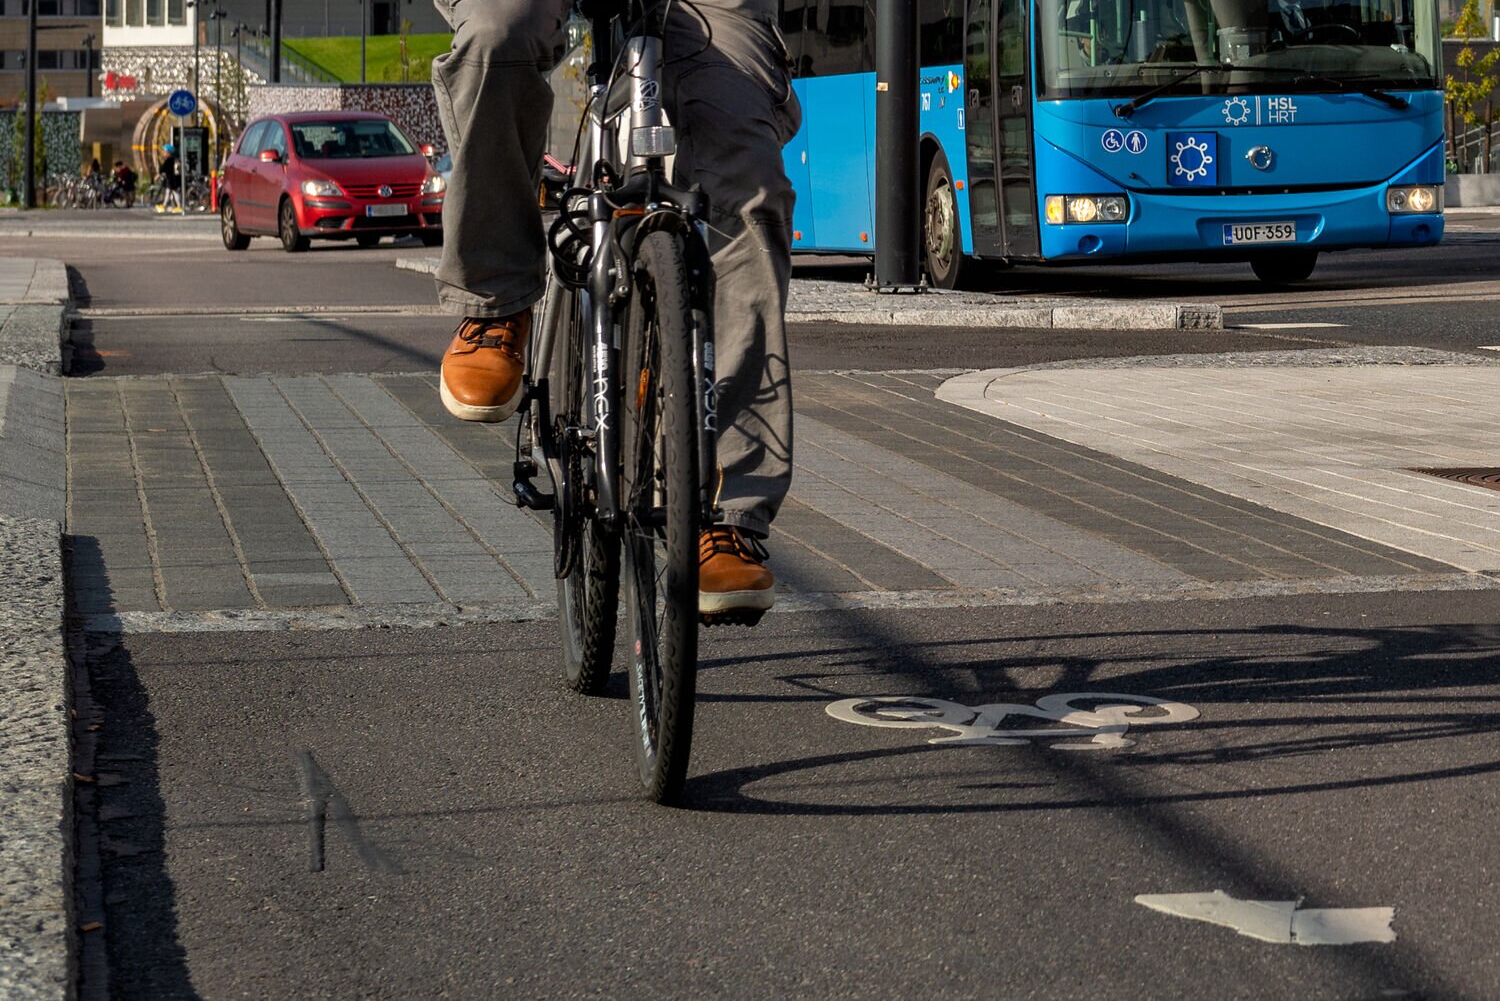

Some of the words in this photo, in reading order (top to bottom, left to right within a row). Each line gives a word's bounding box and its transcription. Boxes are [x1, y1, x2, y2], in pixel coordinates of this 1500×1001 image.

[1268, 97, 1297, 110] HSL
[1268, 110, 1298, 123] HRT
[1234, 224, 1292, 241] UOF-359
